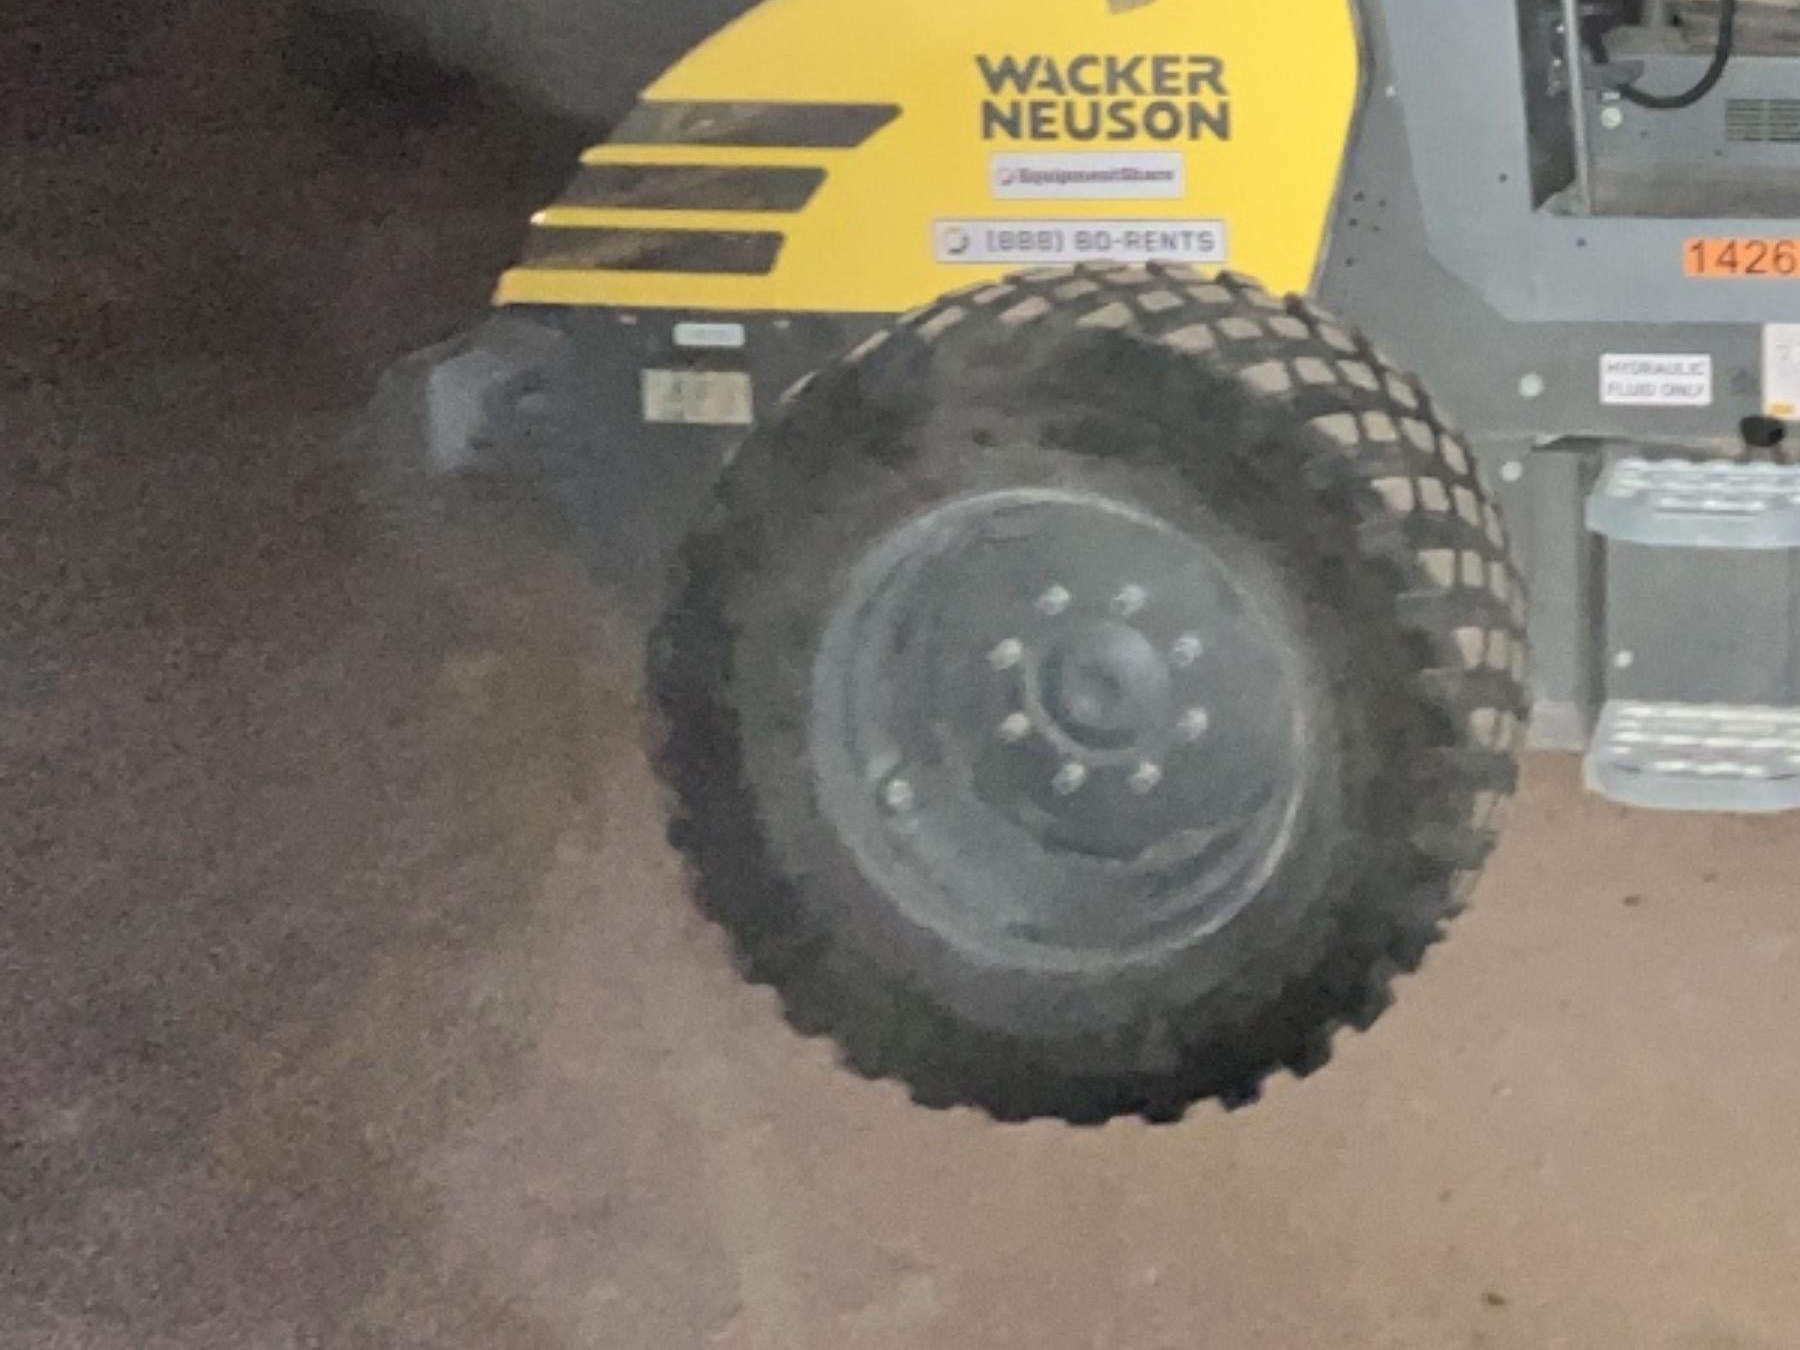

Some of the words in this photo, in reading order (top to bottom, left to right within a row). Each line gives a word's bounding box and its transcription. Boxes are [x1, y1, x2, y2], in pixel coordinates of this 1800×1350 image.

[975, 55, 1229, 96] WACKER
[982, 100, 1231, 141] NEUSON
[1607, 360, 1705, 377] HYDRAULIC
[1607, 381, 1656, 397] FLUID
[1660, 381, 1705, 397] ONLY
